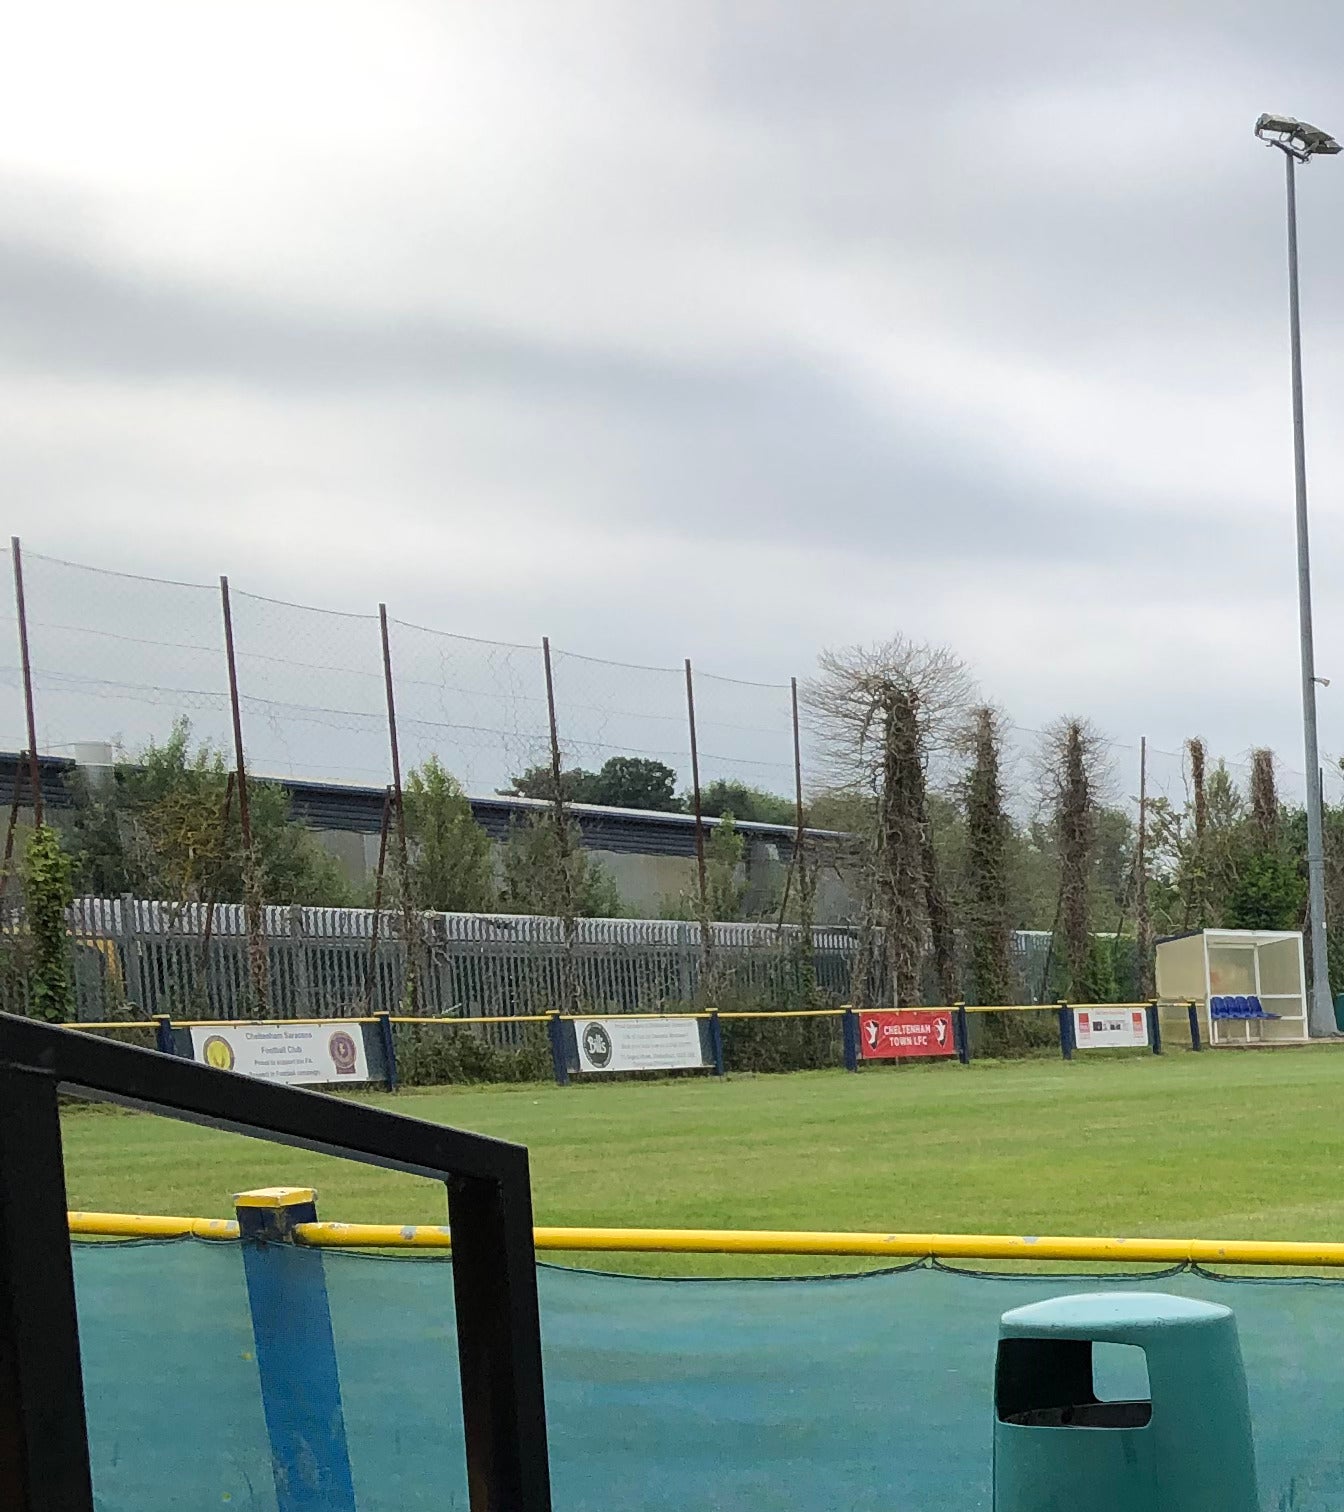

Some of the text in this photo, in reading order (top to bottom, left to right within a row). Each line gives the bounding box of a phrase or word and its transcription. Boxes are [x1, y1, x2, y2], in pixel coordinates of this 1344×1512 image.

[884, 1024, 931, 1035] CHELTENHAM
[245, 1032, 282, 1040] Cheltenham
[889, 1036, 927, 1046] TOWN LFC
[261, 1045, 302, 1054] Football Club
